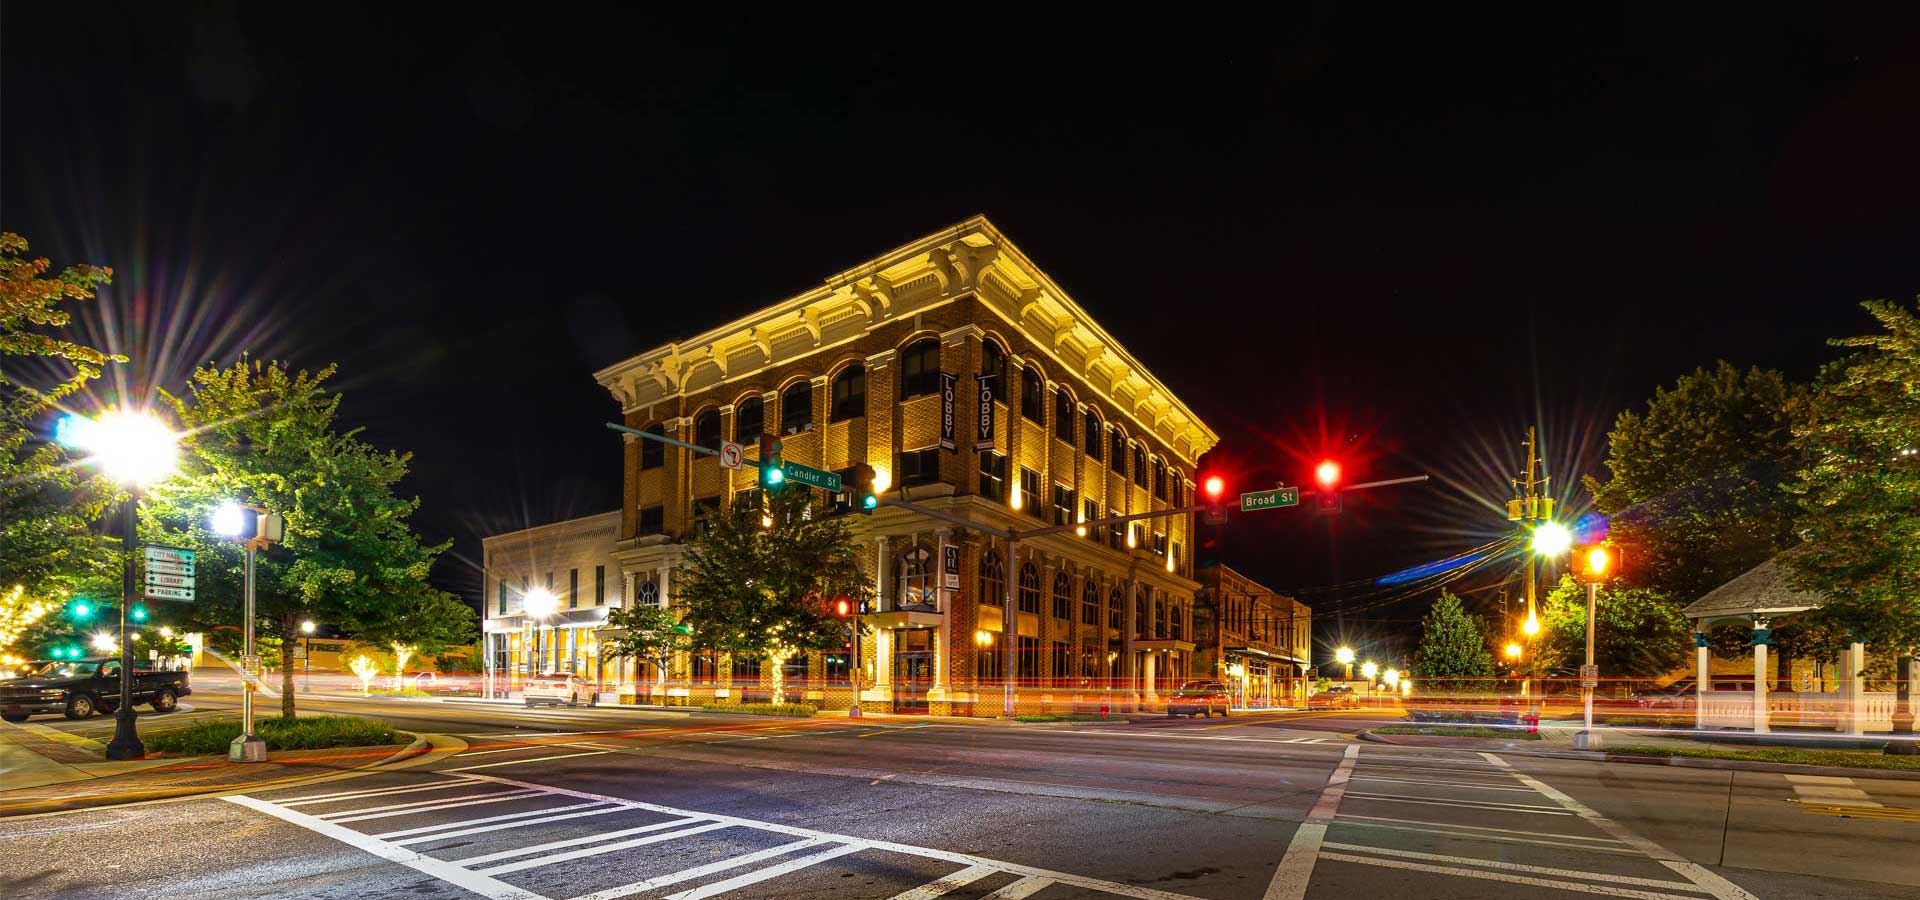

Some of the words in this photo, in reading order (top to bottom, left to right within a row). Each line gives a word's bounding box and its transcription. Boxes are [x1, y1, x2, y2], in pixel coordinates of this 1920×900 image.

[945, 377, 953, 438] LOBBY
[981, 379, 992, 438] LOBBY
[788, 465, 820, 482] Candler
[827, 476, 836, 487] St
[1246, 494, 1275, 506] Broad
[1281, 492, 1293, 502] St
